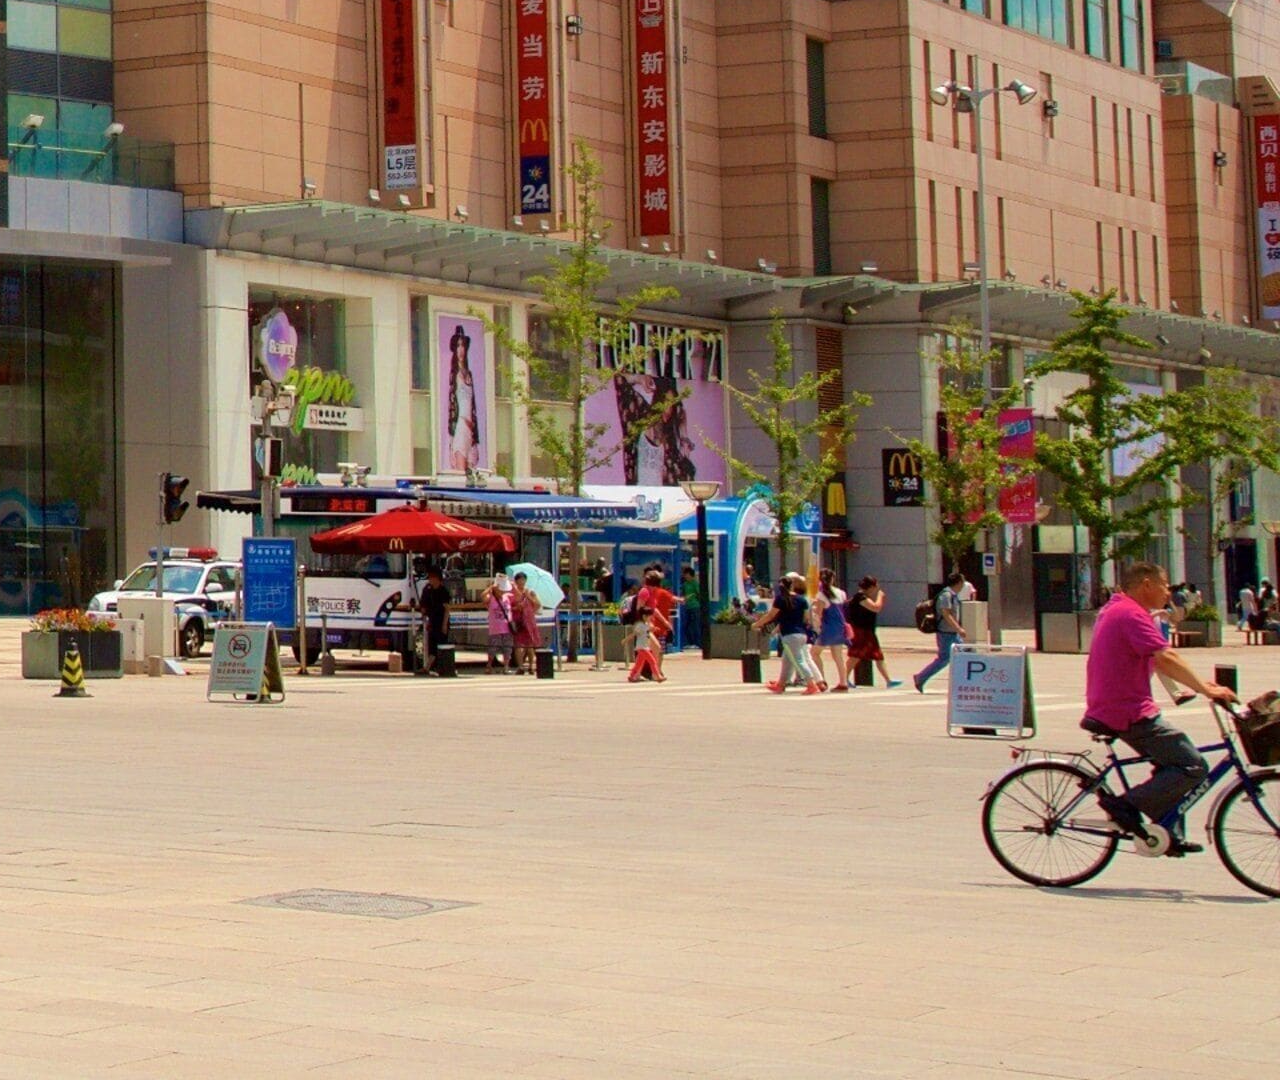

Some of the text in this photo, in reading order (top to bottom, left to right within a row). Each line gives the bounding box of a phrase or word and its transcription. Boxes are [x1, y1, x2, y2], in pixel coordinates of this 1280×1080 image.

[641, 51, 668, 212] 新东安影城
[1260, 126, 1278, 158] 西贝
[387, 156, 416, 170] L5层
[522, 184, 549, 203] 24
[903, 477, 918, 486] 24
[307, 596, 361, 614] 警 POLICE 察
[966, 661, 986, 680] P
[1177, 778, 1210, 814] GIANT
